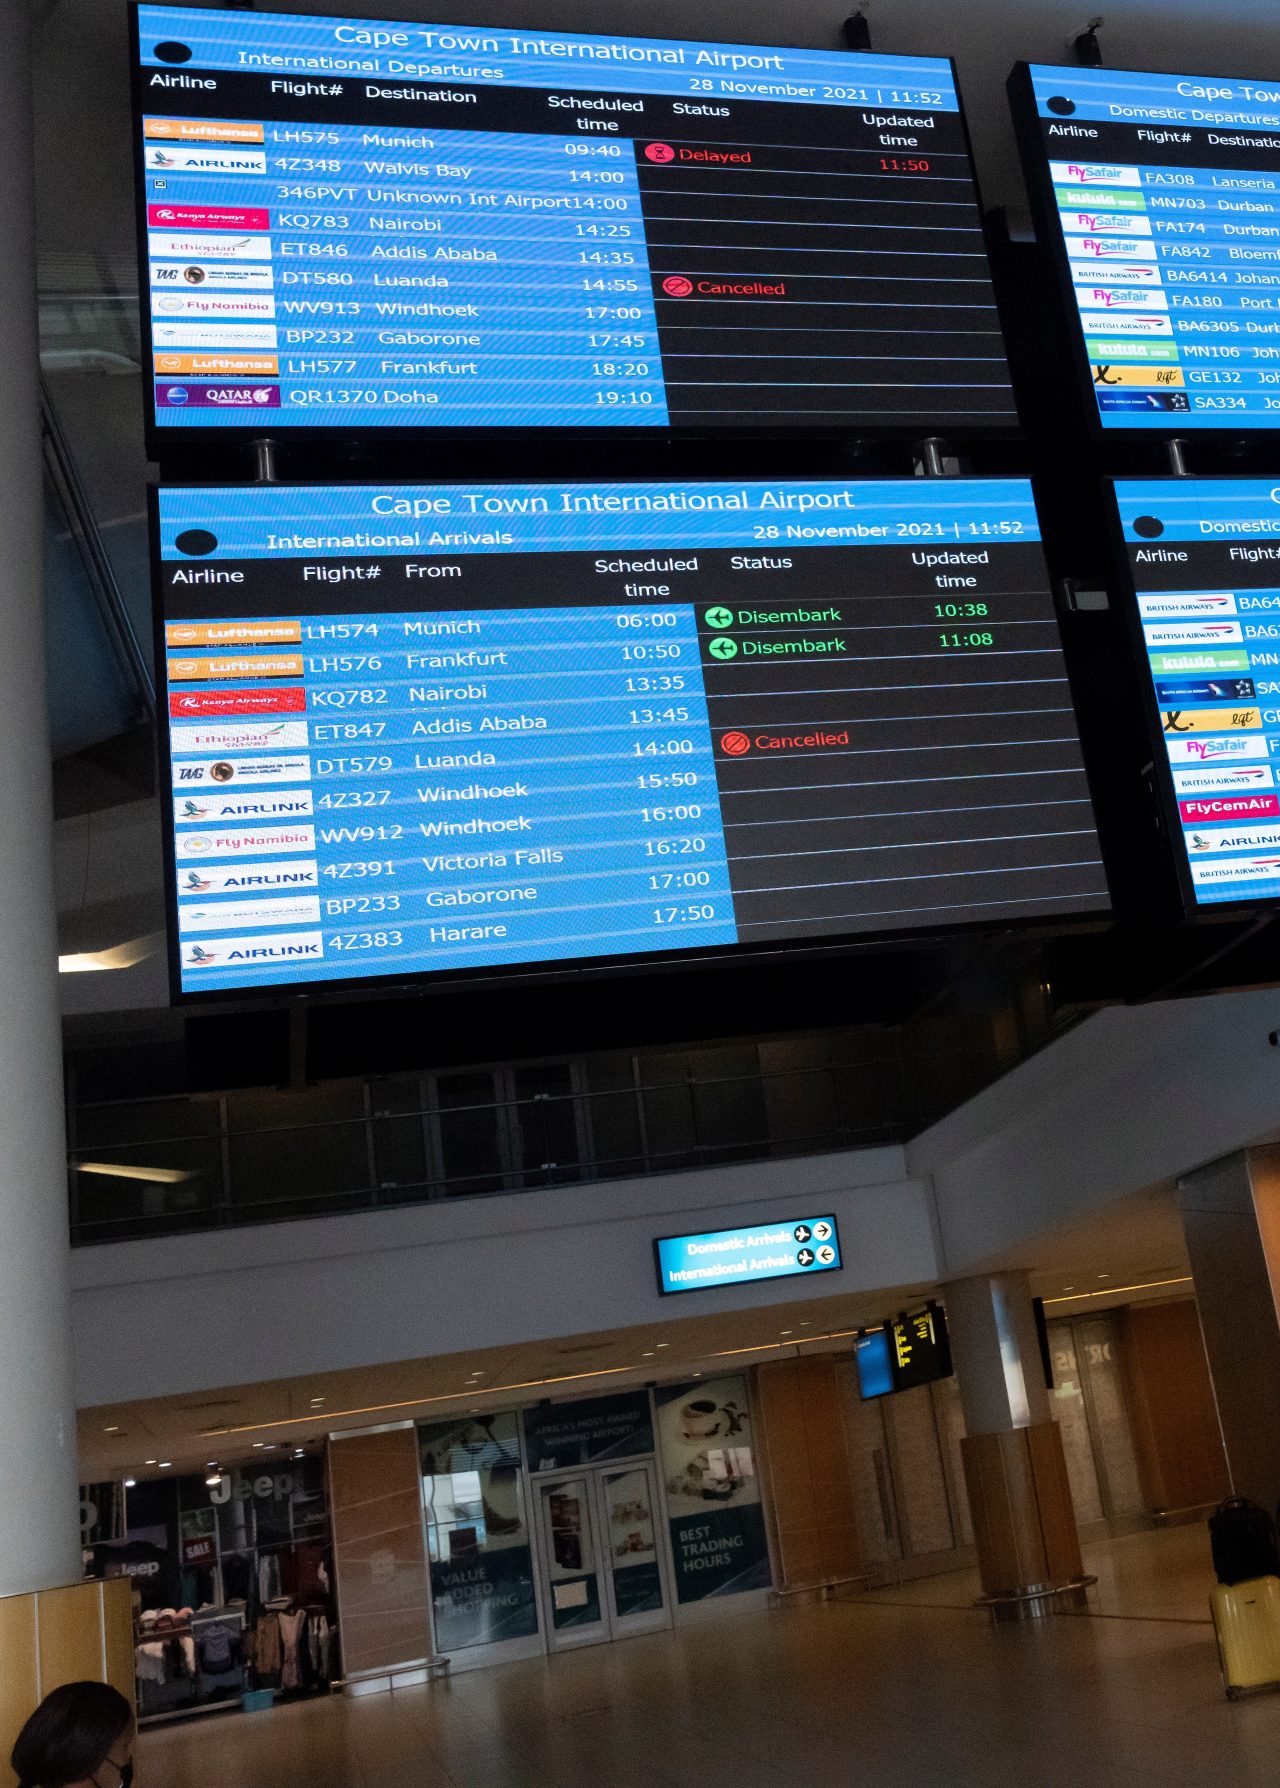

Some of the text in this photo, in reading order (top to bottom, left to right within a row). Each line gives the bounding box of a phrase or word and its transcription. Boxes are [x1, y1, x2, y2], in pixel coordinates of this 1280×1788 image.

[334, 25, 784, 71] Cape Town International Airport
[239, 51, 503, 78] International Departures
[150, 74, 934, 129] Airline Flight# Destination Status Updated
[689, 79, 942, 105] 28 November 2021 11:52
[1177, 82, 1232, 101] Cape
[1110, 105, 1279, 126] Domestic Departures
[273, 130, 929, 172] LH575 Munich Delayed 11:50
[185, 158, 472, 180] AIRLINK 4Z348 Walvis Bay
[1068, 165, 1122, 181] FlySafair
[1146, 172, 1195, 184] FA308
[1212, 176, 1275, 189] Lanseria
[282, 271, 353, 285] DT580
[374, 273, 449, 288] Luanda
[698, 281, 785, 295] Cancelled
[1183, 346, 1240, 358] MN106
[206, 389, 252, 402] QATAR
[371, 490, 854, 517] Cape Town International Airport
[753, 521, 1024, 539] 28 November 2021 11:52
[1200, 519, 1280, 534] Domestic
[267, 530, 513, 550] International Arrivals
[1136, 549, 1188, 562] Airline
[172, 556, 792, 584] Airline Flight# From Status
[1147, 604, 1179, 612] BRITISH
[307, 603, 988, 639] LH574 Munich 06:00 Disembark 10:38
[314, 714, 547, 740] ET847 Addis Ababa
[755, 731, 848, 749] Cancelled
[1186, 798, 1272, 814] FlyCemAir
[228, 922, 507, 960] AIRLINK 4Z383 Harare
[687, 1231, 791, 1256] Domestic Arrivals
[669, 1254, 795, 1282] International Arrivals
[209, 1471, 293, 1505] Jeep
[680, 1526, 711, 1543] BEST
[186, 1540, 210, 1558] SALE
[681, 1535, 744, 1557] TRADING
[683, 1553, 731, 1572] HOURS
[441, 1568, 486, 1587] VALUE
